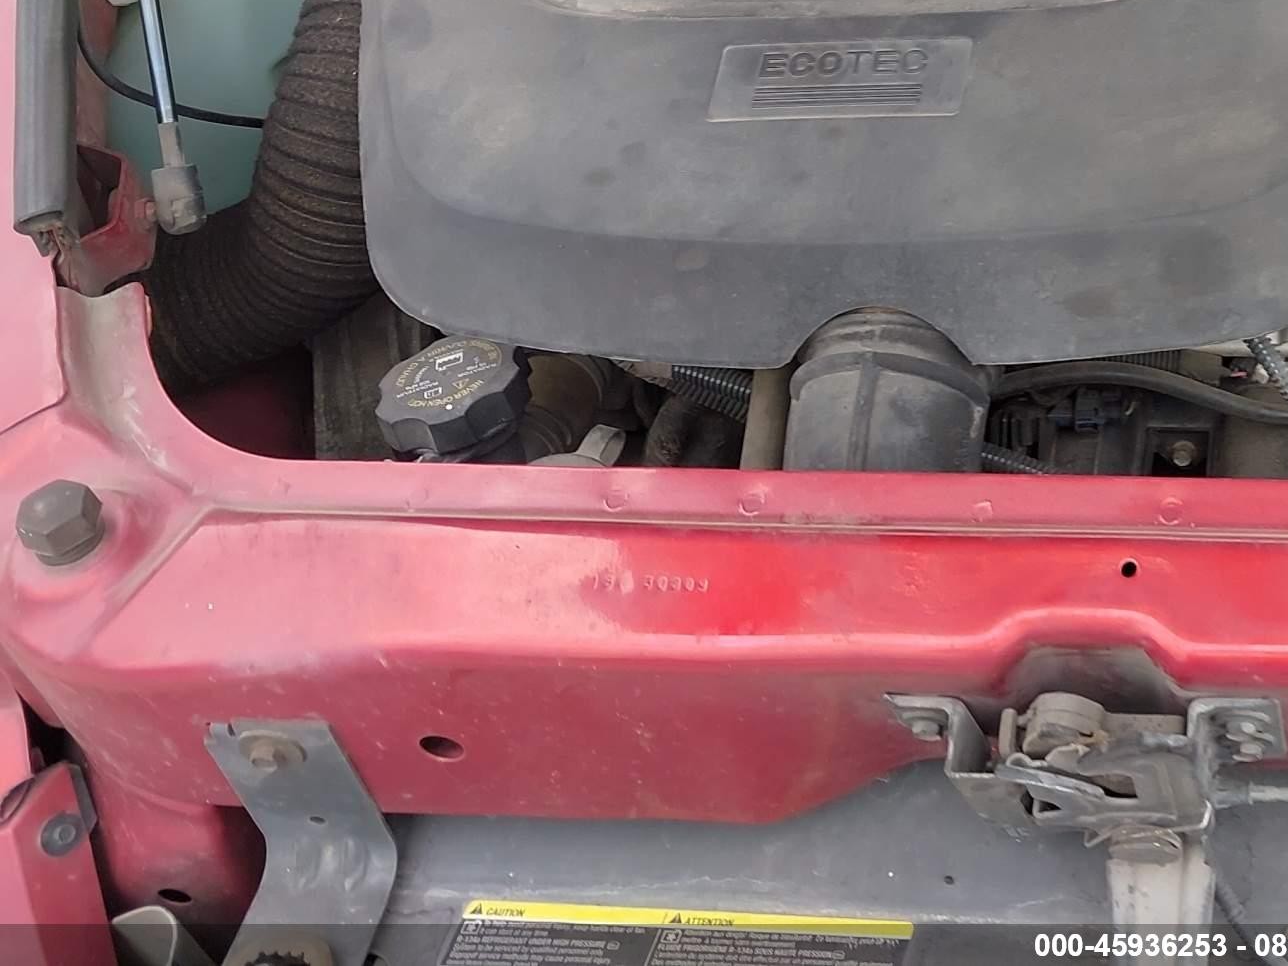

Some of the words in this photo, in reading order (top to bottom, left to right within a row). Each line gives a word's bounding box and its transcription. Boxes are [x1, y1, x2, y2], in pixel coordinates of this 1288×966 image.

[758, 48, 929, 79] ECOTEC
[453, 379, 484, 400] NEVER
[486, 908, 526, 918] CAUTION
[685, 918, 734, 927] ATTENTION
[570, 940, 606, 949] PRESSURE
